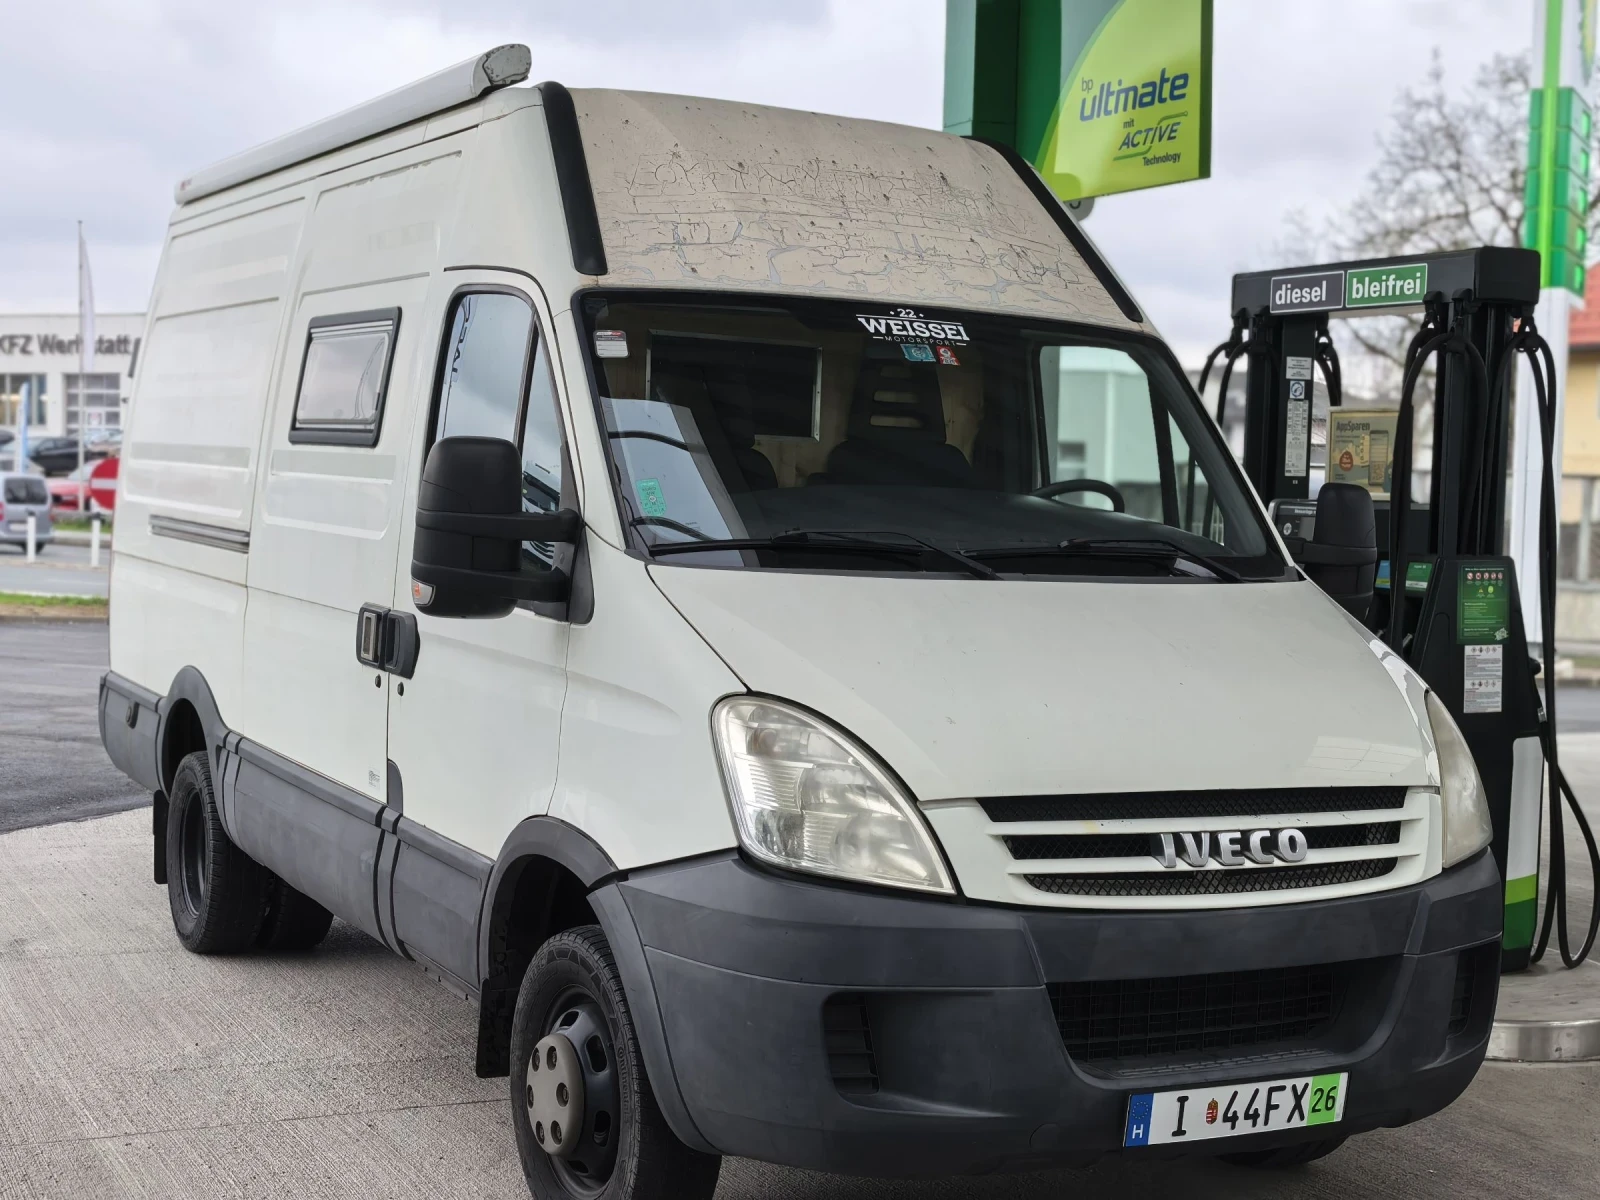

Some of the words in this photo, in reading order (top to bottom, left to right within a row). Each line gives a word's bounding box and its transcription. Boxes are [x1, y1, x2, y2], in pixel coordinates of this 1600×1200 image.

[1079, 68, 1189, 122] ultimate
[1082, 77, 1093, 93] bp
[1123, 118, 1135, 129] mit
[1118, 121, 1181, 151] ACTIVE
[1142, 152, 1182, 167] Technology
[1275, 280, 1327, 305] diesel
[1352, 272, 1421, 299] bleifrei
[896, 308, 917, 319] 22
[37, 333, 132, 355] Werktatt
[884, 335, 957, 346] MOTORSPORT
[1335, 420, 1371, 432] AppSparen
[1159, 828, 1308, 868] IVECO
[1131, 1123, 1144, 1139] H
[1171, 1095, 1190, 1137] I
[1221, 1082, 1310, 1131] 44FX
[1311, 1086, 1337, 1114] 26
